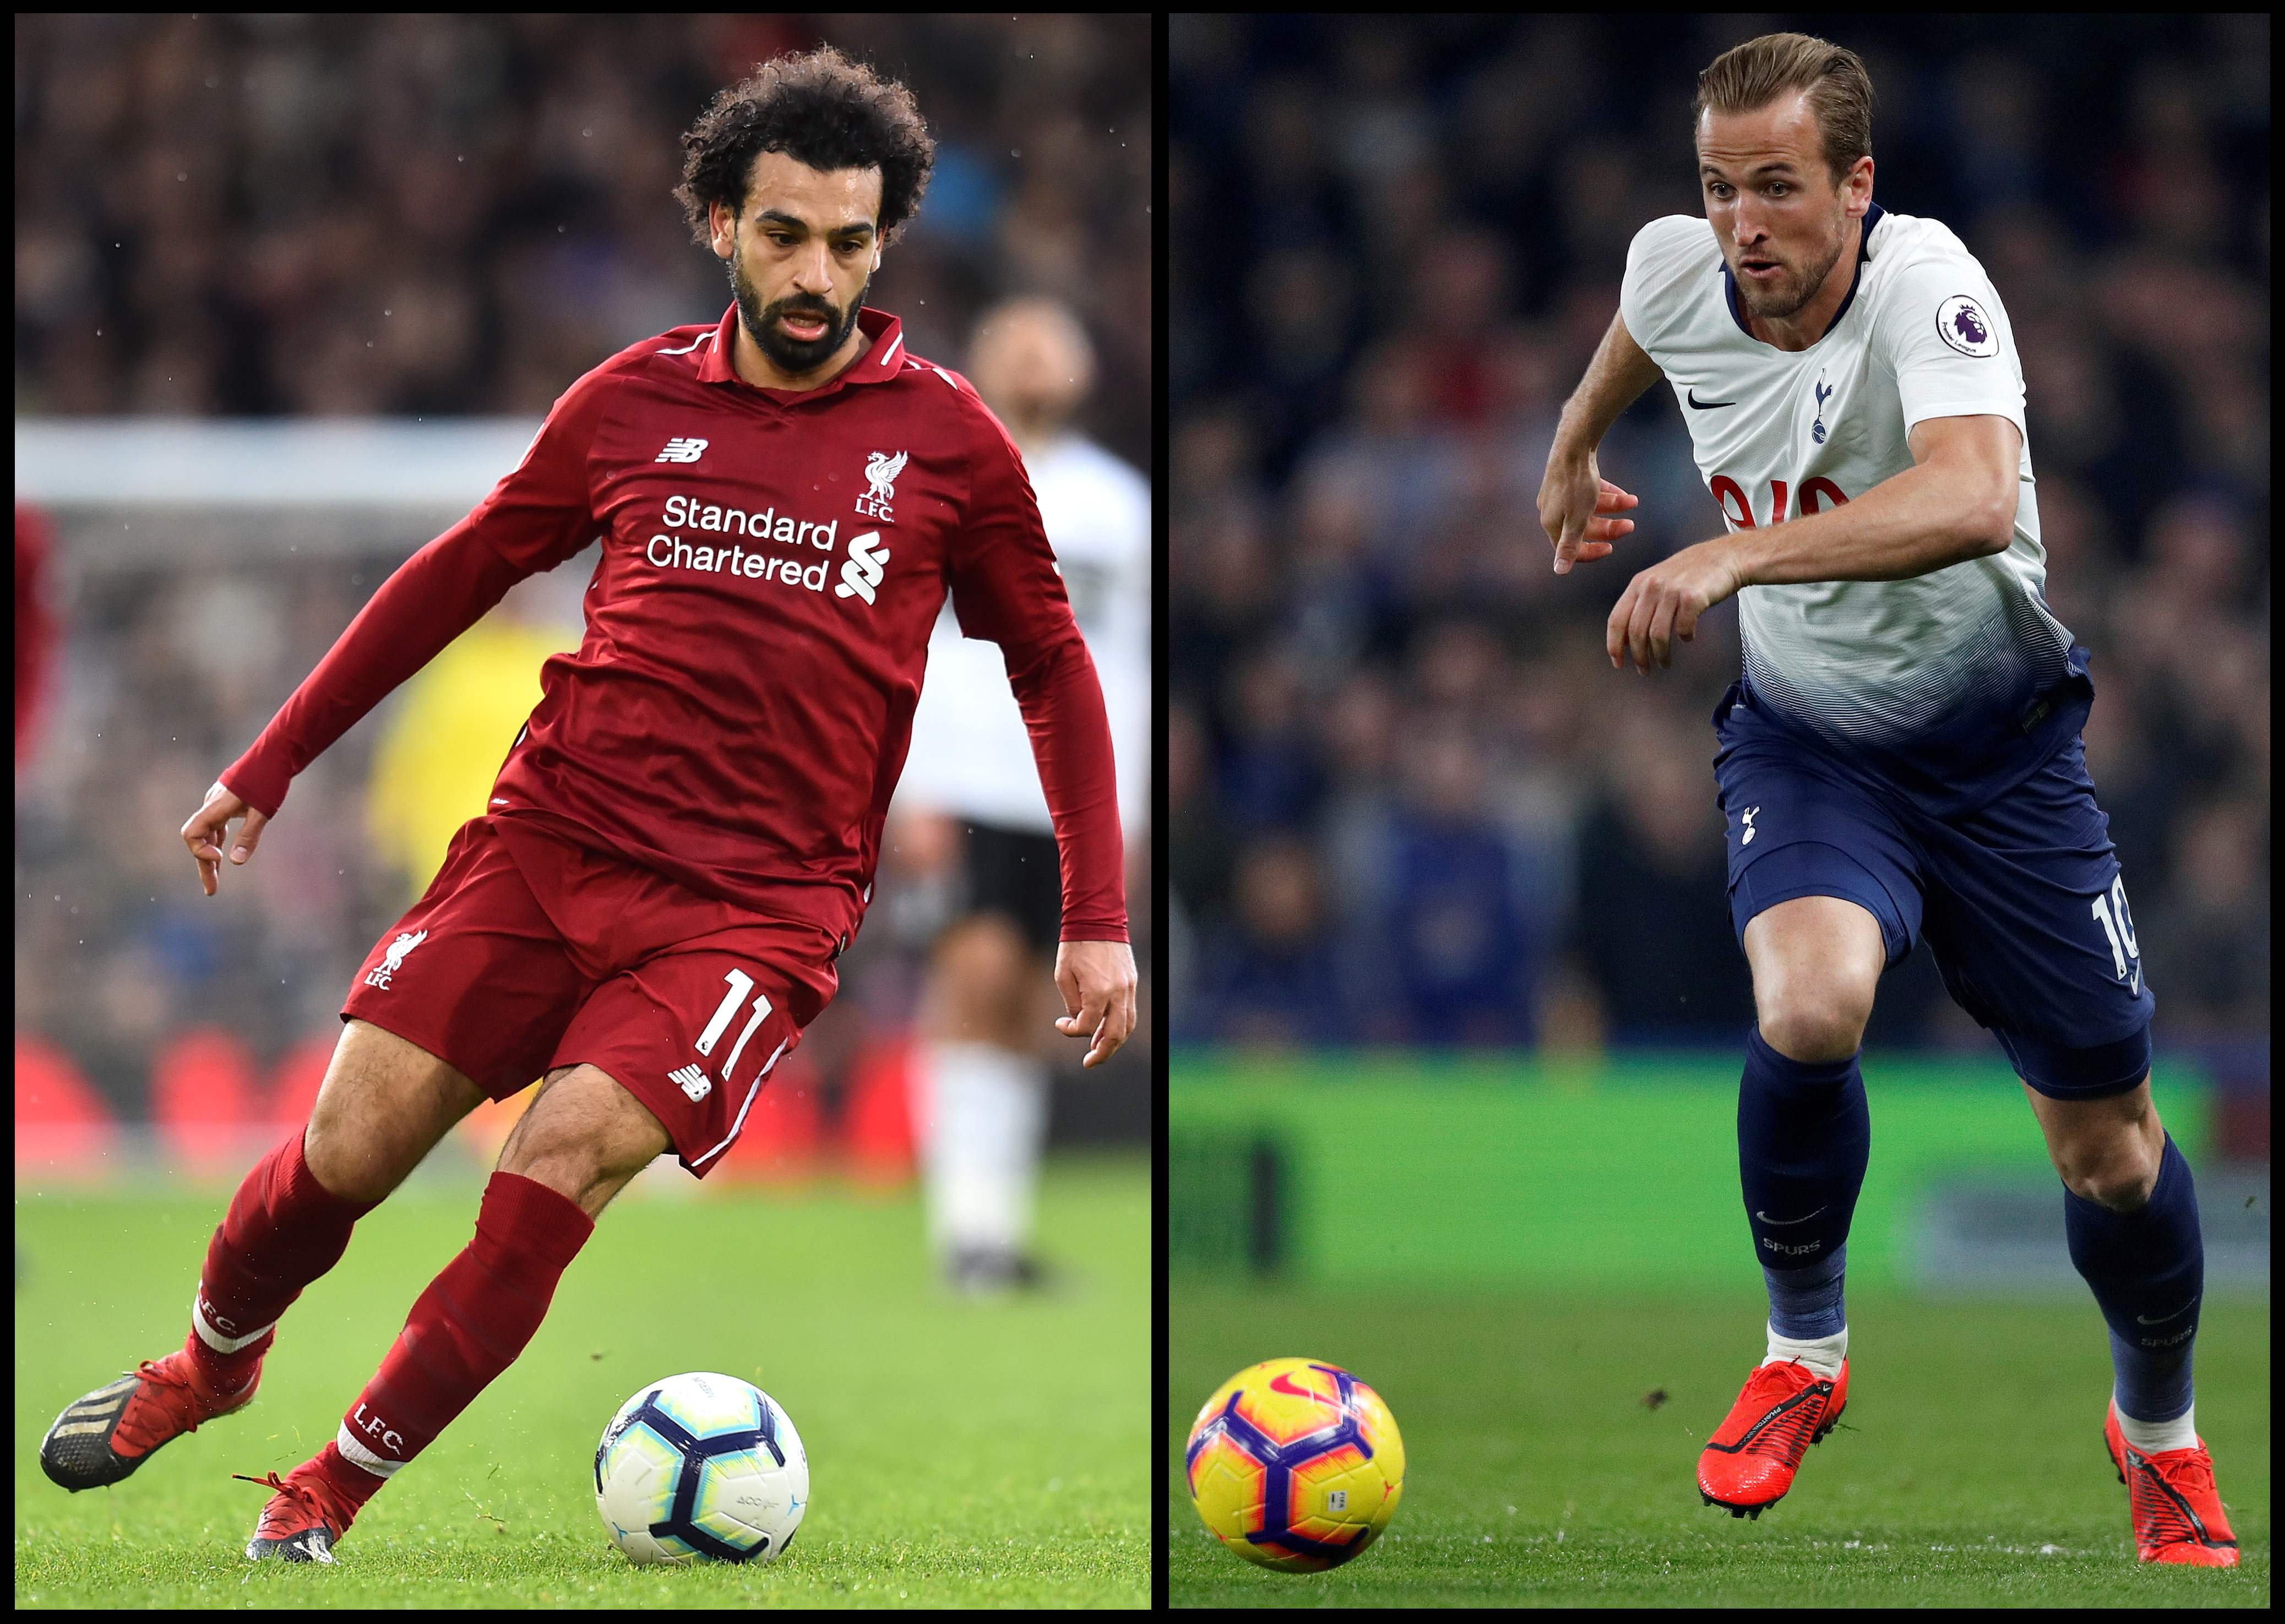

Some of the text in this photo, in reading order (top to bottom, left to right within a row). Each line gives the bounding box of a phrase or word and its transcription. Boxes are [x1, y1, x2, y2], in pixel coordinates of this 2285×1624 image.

[662, 495, 838, 551] Standard
[647, 535, 829, 592] Chartered
[2091, 872, 2140, 980] 10
[694, 967, 773, 1082] 11
[1764, 1238, 1820, 1255] SPURS
[2141, 1326, 2192, 1348] SPURS
